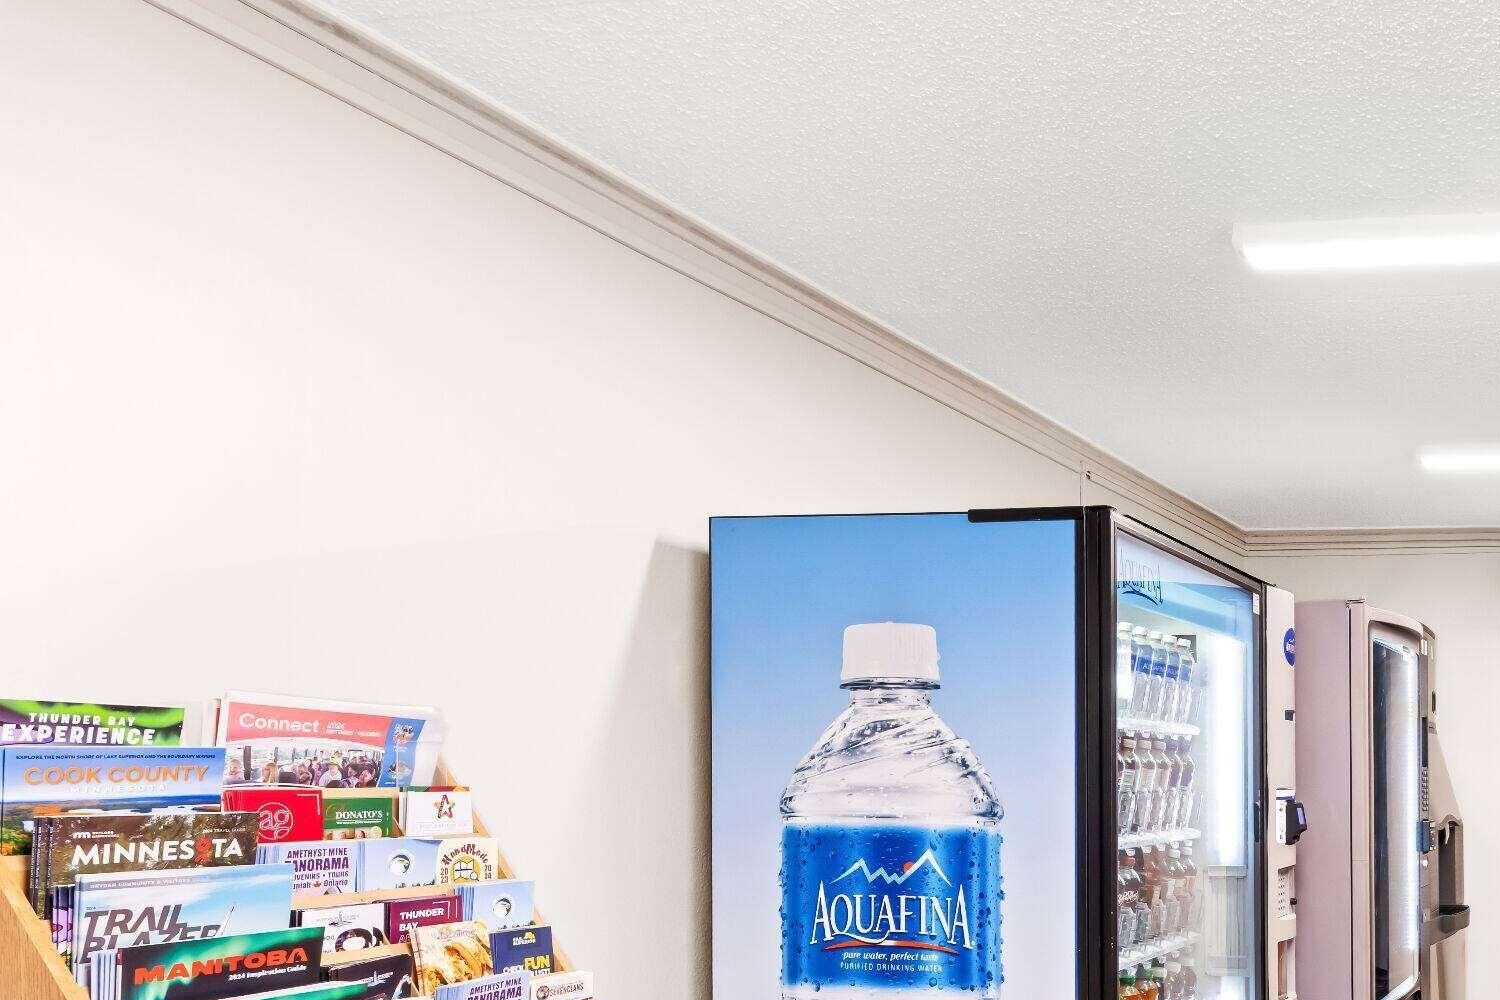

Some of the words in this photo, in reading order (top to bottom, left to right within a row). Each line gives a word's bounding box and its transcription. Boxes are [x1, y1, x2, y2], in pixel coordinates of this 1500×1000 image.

[29, 712, 101, 726] THUNDER
[107, 716, 136, 727] BAY
[238, 712, 320, 733] Connect
[0, 723, 156, 745] EXPERIENCE
[23, 765, 102, 786] COOK
[107, 764, 209, 783] COUNTY
[69, 784, 166, 794] MINNESOTA
[335, 810, 383, 820] DONATO'S
[287, 849, 327, 859] AMETHYST
[328, 847, 348, 857] MINE
[285, 857, 349, 872] ANORAMA
[323, 879, 348, 887] Ontario
[84, 904, 183, 936] TRAIL
[400, 907, 444, 920] THUNDER
[809, 880, 974, 949] AQUAFINA
[399, 922, 419, 931] BAY
[524, 955, 551, 971] FUN
[842, 952, 861, 960] pure
[863, 952, 888, 961] water,
[890, 952, 918, 961] perfect
[920, 953, 939, 962] taste
[134, 947, 308, 985] MANITOBA
[228, 972, 246, 981] 2024
[246, 968, 286, 979] Inspiration
[286, 964, 307, 973] Guide
[840, 962, 873, 971] PURIFIED
[877, 964, 915, 972] DRINKING
[917, 964, 943, 972] WATER
[470, 981, 504, 995] AMETHYST
[505, 977, 522, 987] MINE
